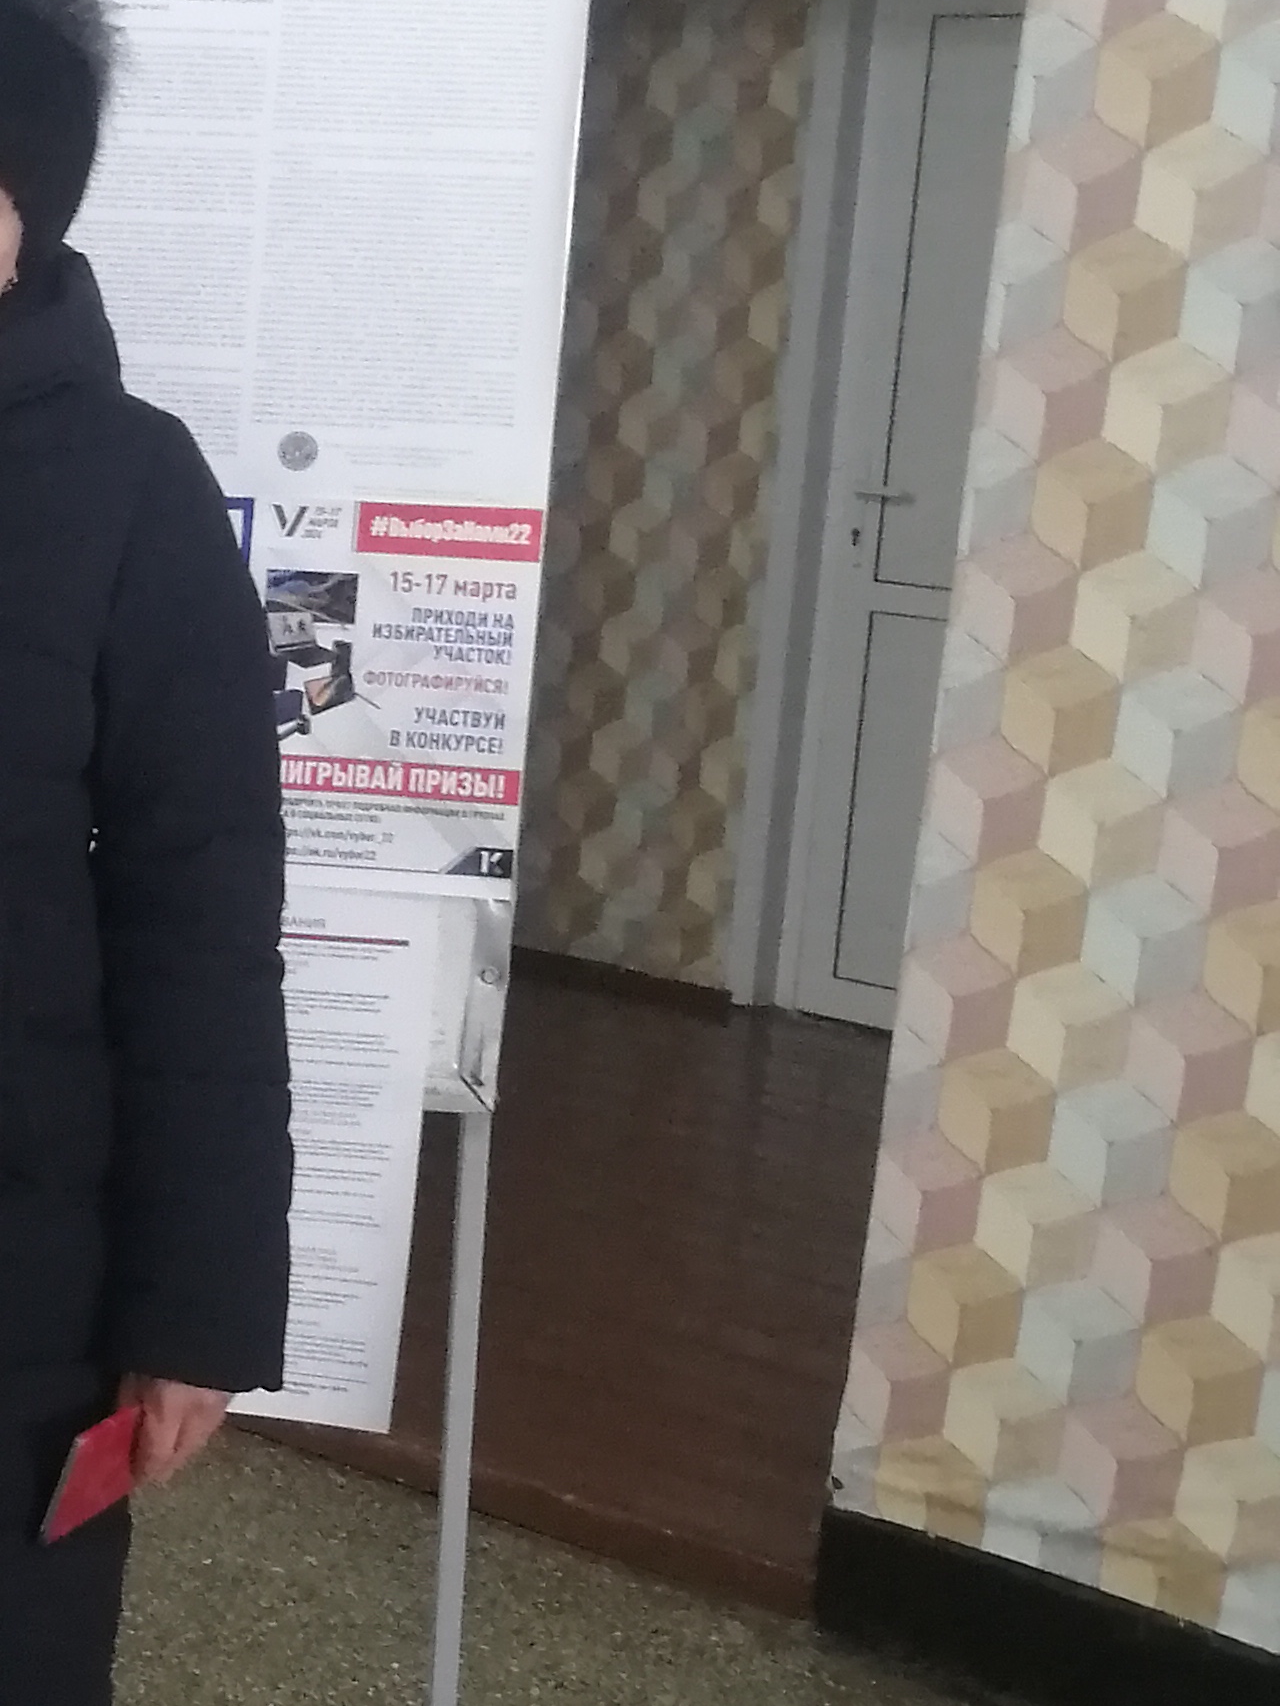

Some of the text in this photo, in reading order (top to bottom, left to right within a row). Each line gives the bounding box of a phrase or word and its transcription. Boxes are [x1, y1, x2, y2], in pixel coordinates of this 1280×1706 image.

[390, 571, 517, 602] 15-17 марта
[411, 607, 515, 629] ПРИХОДИ НА
[433, 645, 512, 666] УЧАСТОК!
[362, 670, 509, 695] ФОТОГРАФИРУЙСЯ!
[390, 730, 504, 755] В КОНКУРСЕ!
[282, 759, 506, 799] ИГРЫВАЙ ПРИЗЫ!
